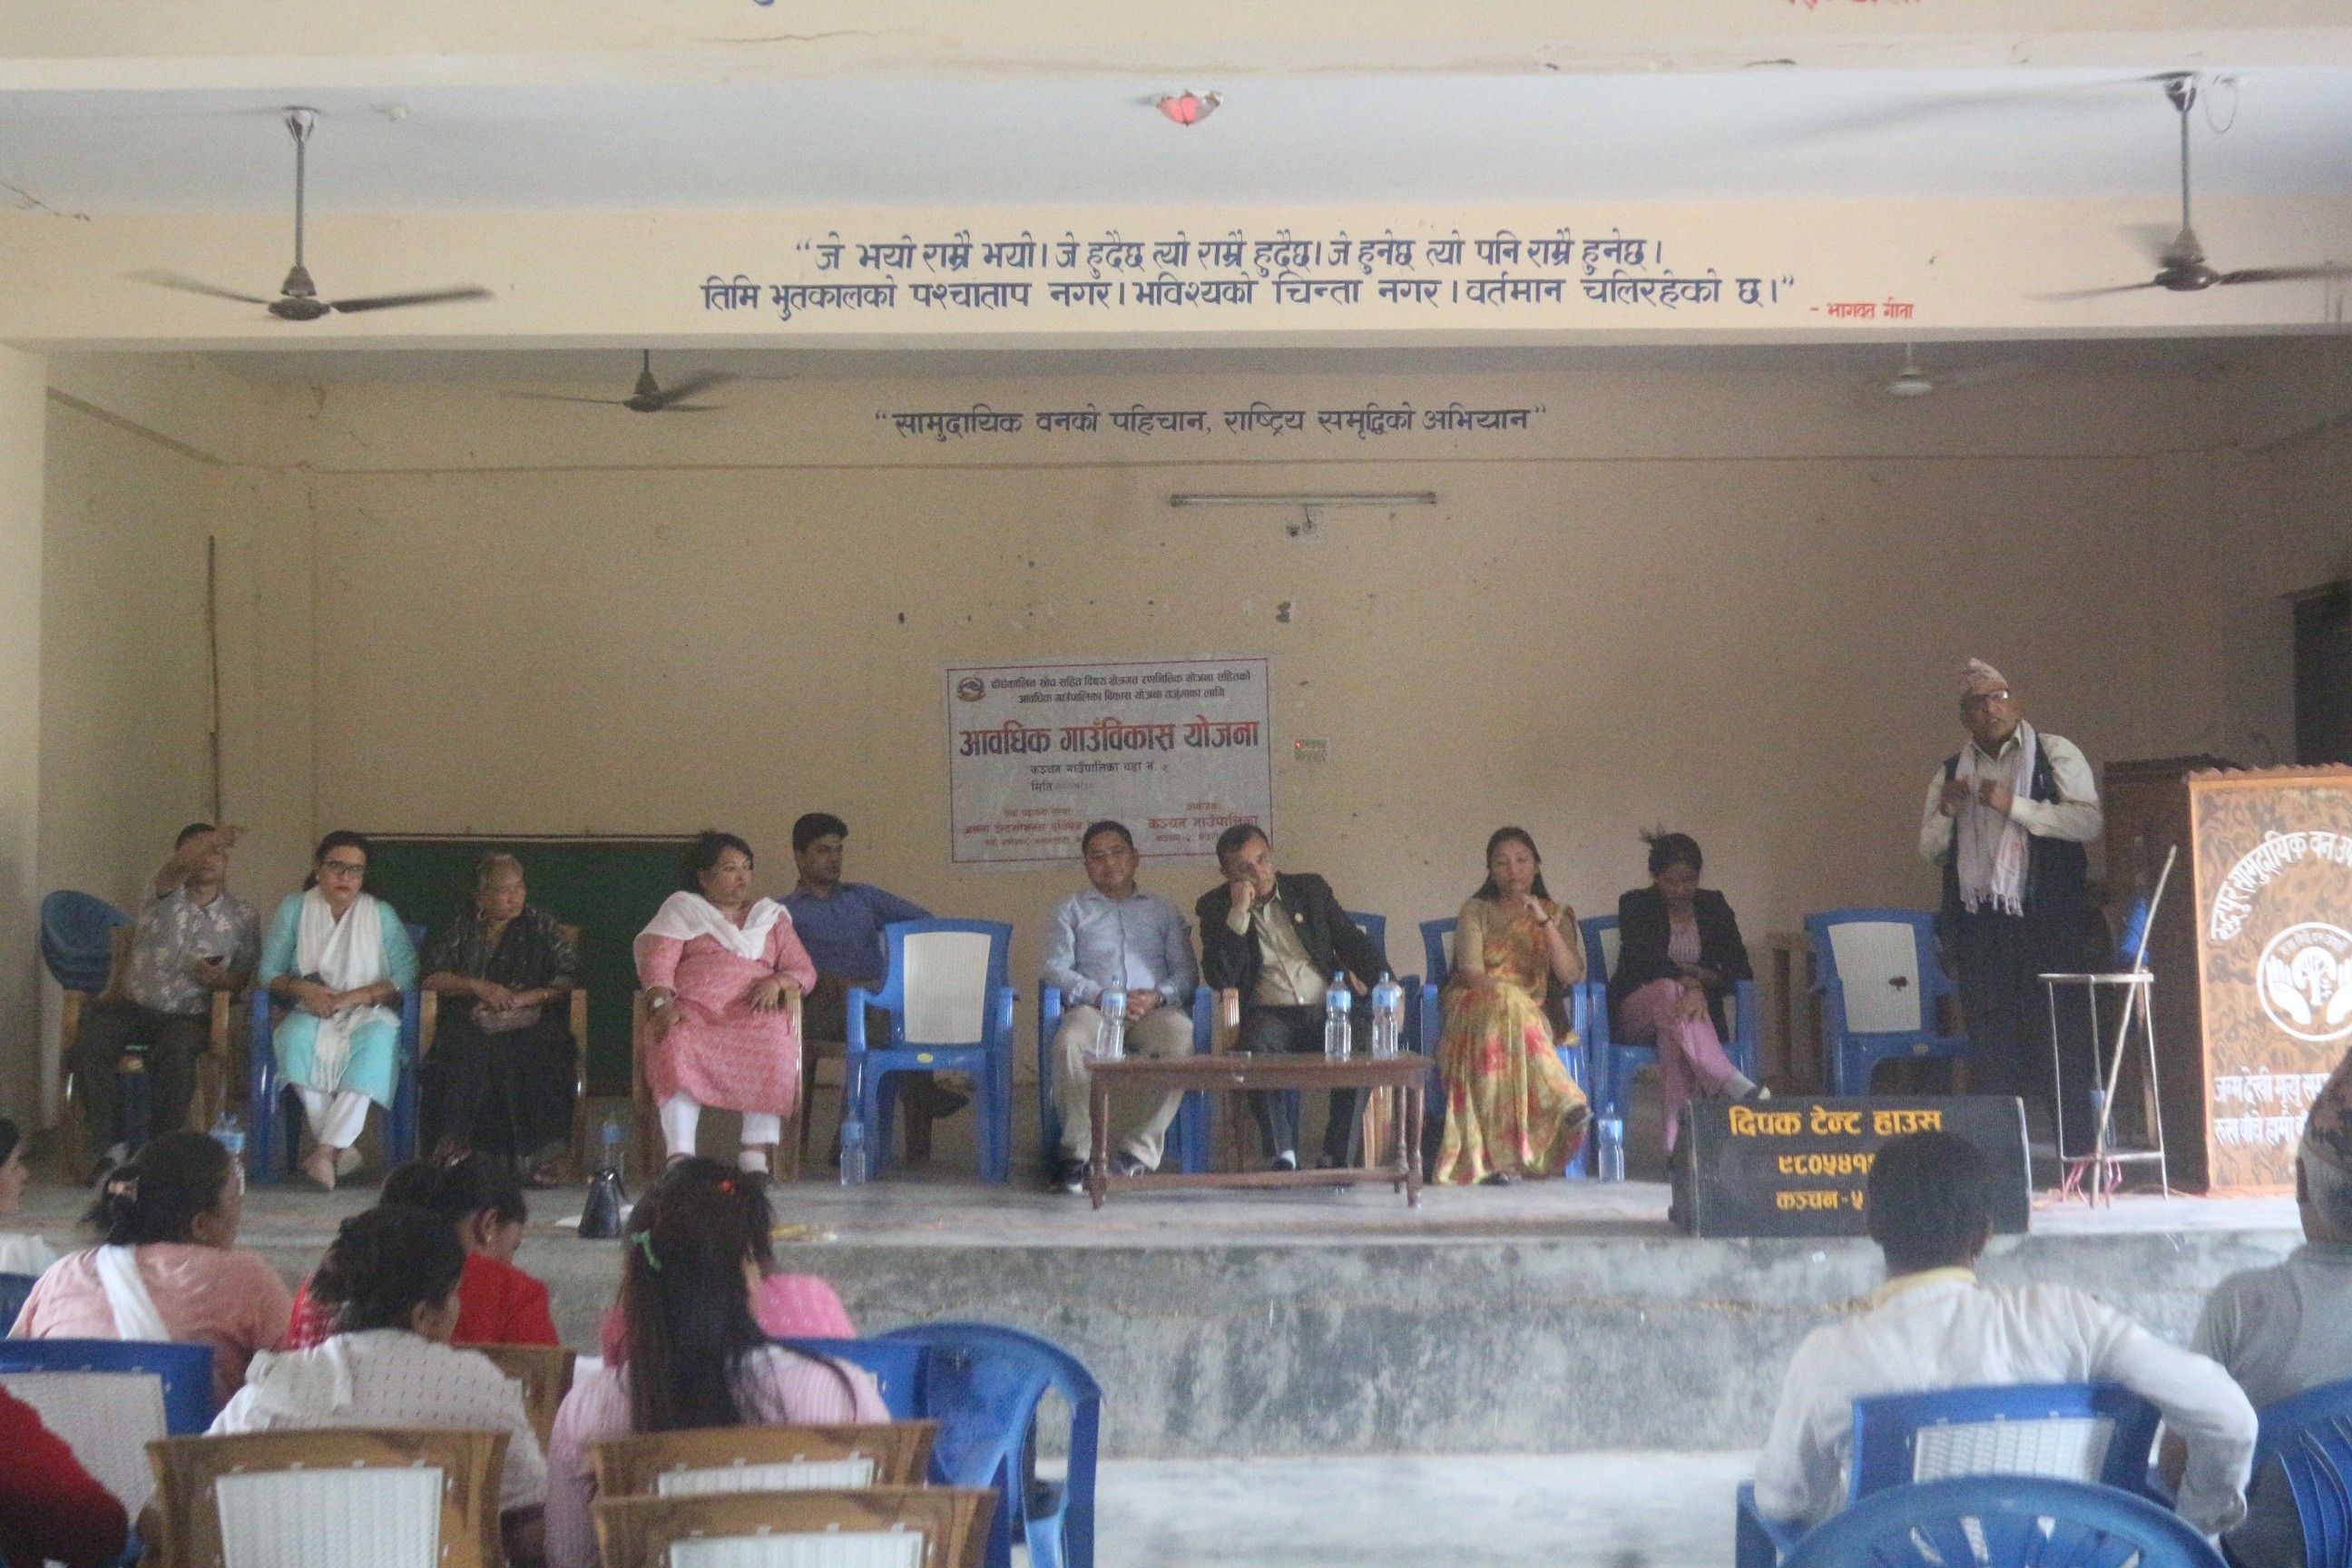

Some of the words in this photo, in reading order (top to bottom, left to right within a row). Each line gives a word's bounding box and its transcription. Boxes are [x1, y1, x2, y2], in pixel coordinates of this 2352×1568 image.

[856, 233, 917, 270] भयो
[922, 229, 974, 272] राम्रै
[1055, 230, 1081, 269] जे
[1152, 230, 1191, 270] त्यो
[1197, 229, 1248, 270] राम्रै
[1328, 230, 1353, 266] जे
[1357, 228, 1416, 276] हुनेछ
[1426, 229, 1466, 267] त्यो
[1474, 229, 1523, 266] पनि
[1527, 227, 1576, 269] राम्रै
[700, 274, 762, 311] तिमि
[769, 273, 898, 322] भुतकालको
[908, 281, 1033, 310] पश्चाताप
[1271, 270, 1364, 306] चिन्ता
[1465, 270, 1567, 309] वर्तमान
[1579, 267, 1723, 310] चलिरहेको
[1882, 296, 1916, 319] गीता
[1035, 403, 1100, 433] वनको
[1108, 404, 1211, 436] पहिचान,
[1223, 401, 1307, 436] राष्ट्रिय
[959, 720, 1052, 757] आवधिक
[1059, 716, 1176, 752] गाउँविकास
[1182, 713, 1260, 750] योजना
[2226, 829, 2308, 894] सामुदायिक
[1728, 1104, 1801, 1136] दिपक
[1810, 1103, 1862, 1135] टेन्ट
[1872, 1110, 1942, 1135] हाउस
